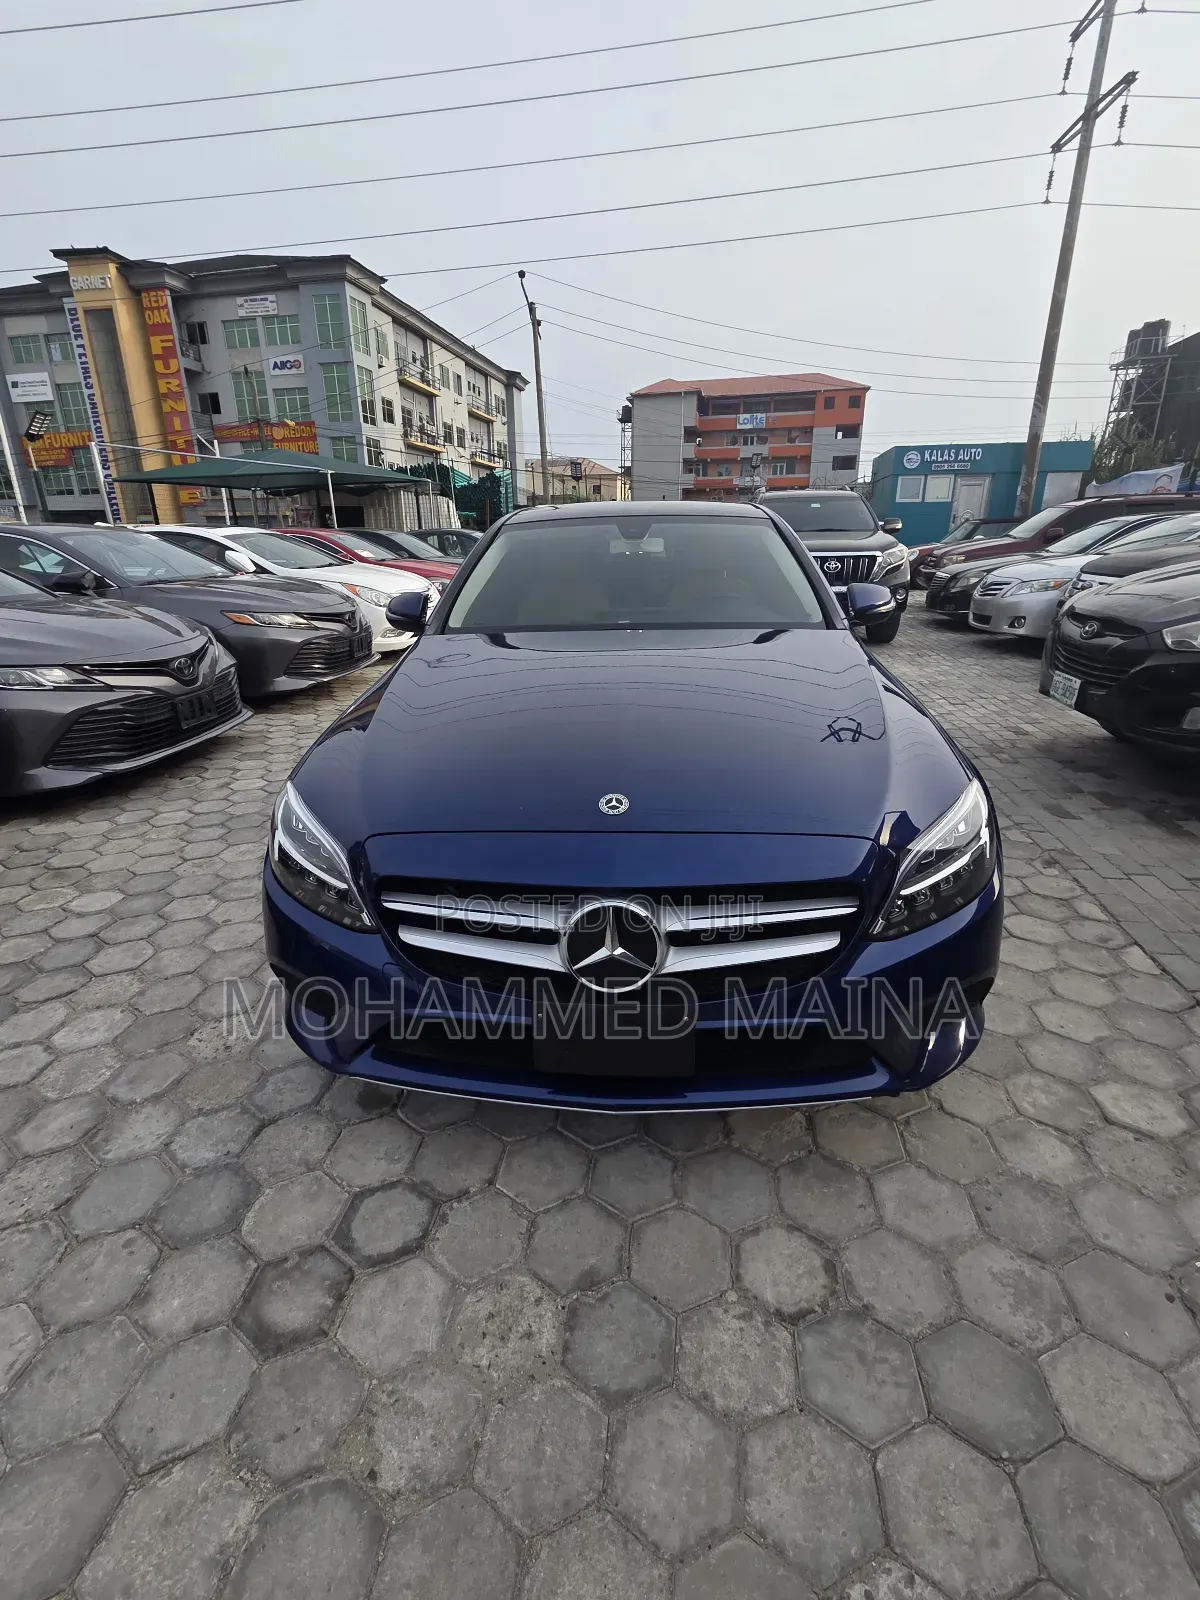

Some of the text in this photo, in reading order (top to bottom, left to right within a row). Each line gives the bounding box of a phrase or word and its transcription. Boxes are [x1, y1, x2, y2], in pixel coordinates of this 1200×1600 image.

[70, 274, 112, 290] GARNET
[142, 291, 167, 308] RED
[145, 308, 172, 325] OAK
[150, 335, 203, 503] FURNITUE
[273, 440, 319, 453] FURNITURE
[924, 448, 982, 462] KALAS AUTO
